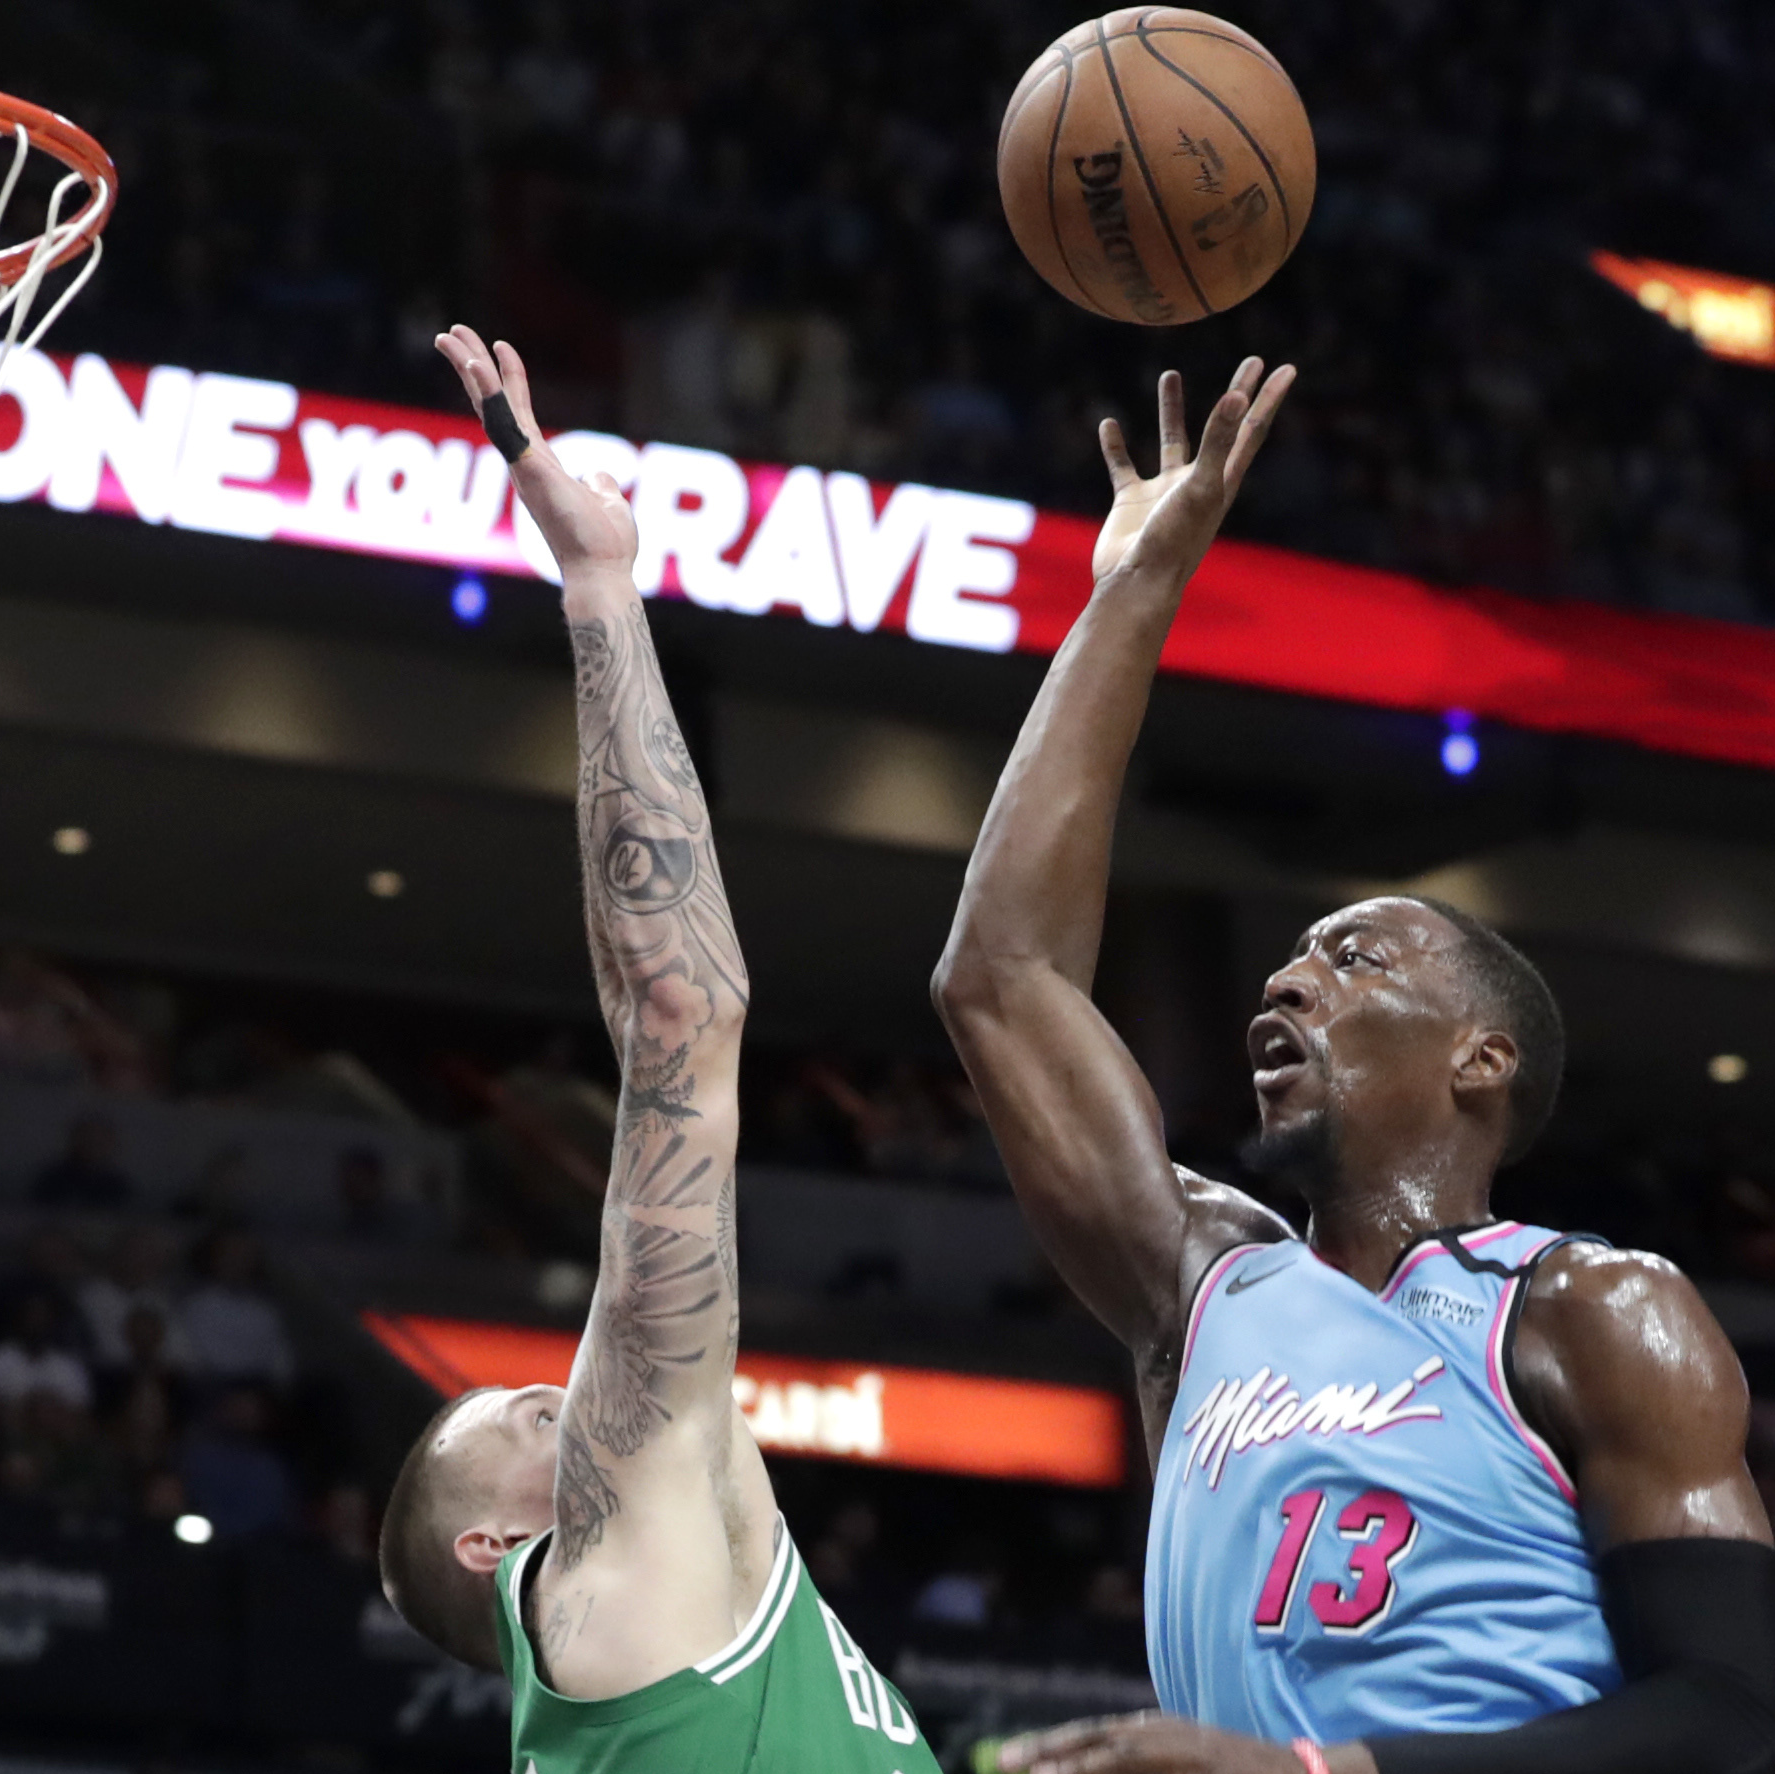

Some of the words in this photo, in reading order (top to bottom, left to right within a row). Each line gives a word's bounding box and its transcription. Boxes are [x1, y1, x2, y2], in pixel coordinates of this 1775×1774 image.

[298, 415, 509, 545] YOU
[1181, 1355, 1443, 1490] Miami
[1254, 1489, 1420, 1636] 13
